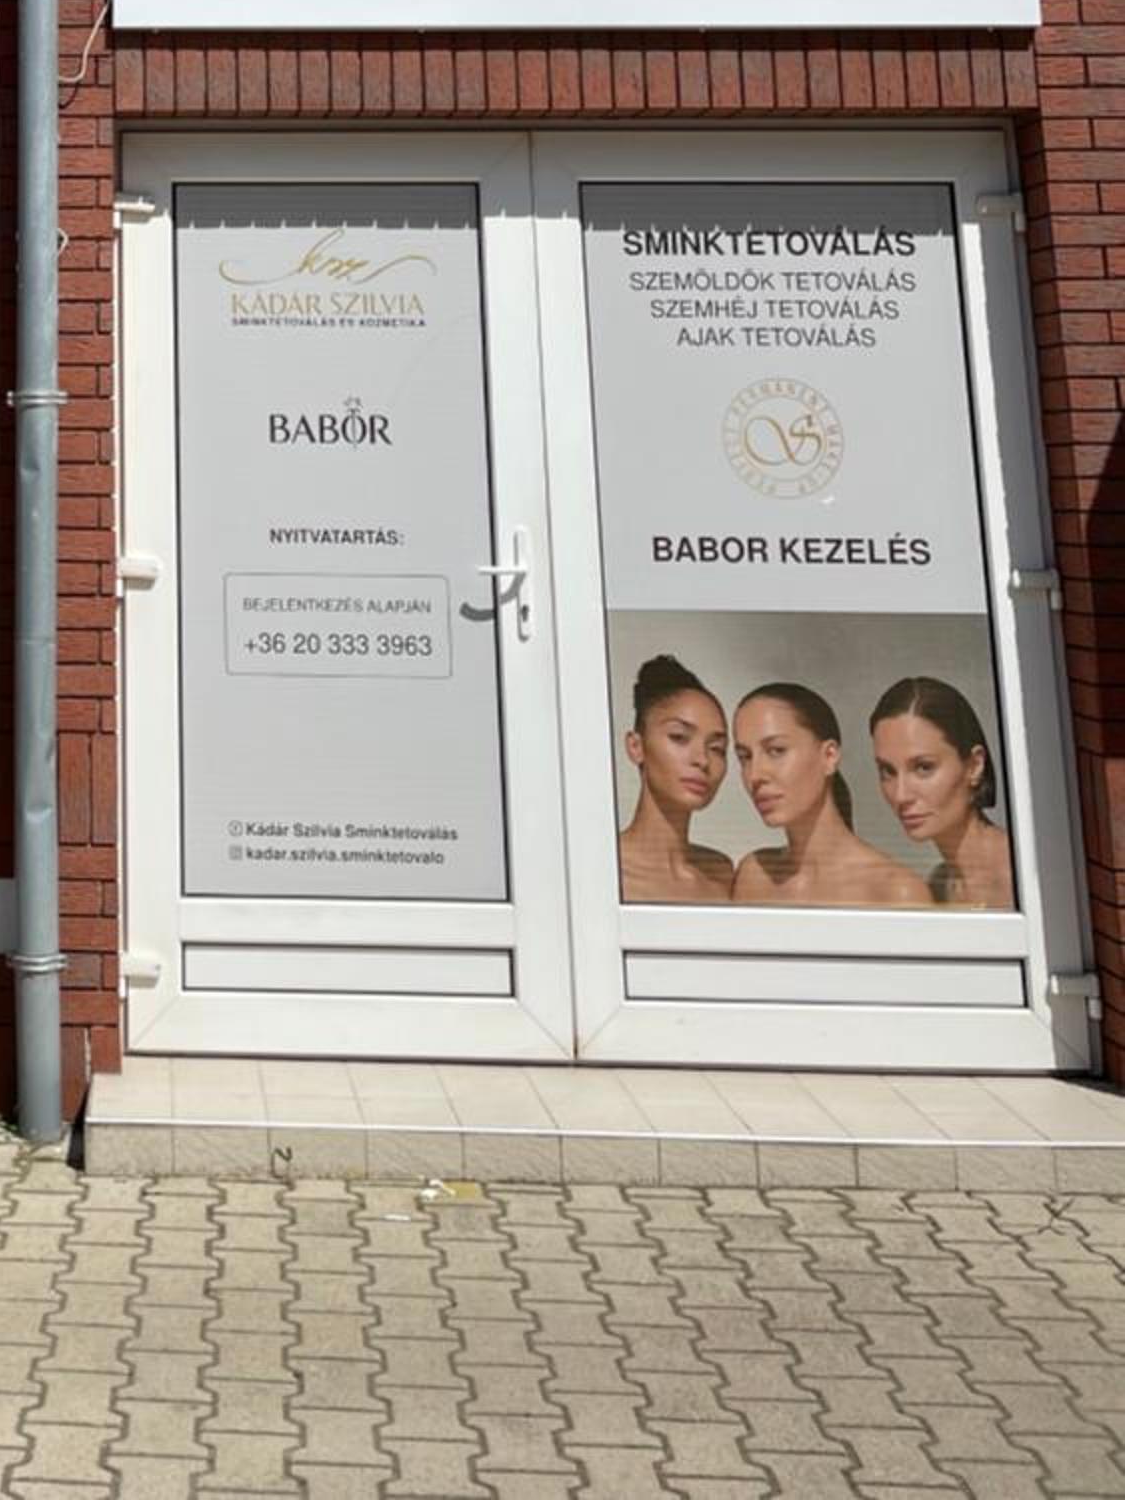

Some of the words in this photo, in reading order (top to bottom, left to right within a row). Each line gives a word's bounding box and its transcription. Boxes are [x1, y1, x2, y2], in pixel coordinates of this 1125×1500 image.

[623, 225, 917, 256] SMINKTETOVÁLÁS
[629, 267, 776, 292] SZEMÖLDÖK
[780, 267, 917, 293] TETOVÁLÁS
[330, 292, 426, 316] SZILVIA
[650, 296, 759, 319] SZEMHÉJ
[764, 296, 901, 320] TETOVÁLÁS
[676, 326, 736, 348] AJAK
[740, 324, 877, 348] TETOVÁLÁS
[268, 398, 393, 446] BABOR
[269, 527, 405, 546] NYITVATARTÁS:
[652, 536, 769, 564] BABOR
[779, 533, 932, 566] KEZELÉS
[242, 596, 364, 613] BEJELENTKEZÉS
[366, 598, 433, 614] ALAPJÁN
[244, 631, 287, 655] +36
[292, 632, 322, 655] 20
[327, 633, 370, 656] 333
[376, 634, 433, 657] 3963
[292, 821, 342, 839] Szilvia
